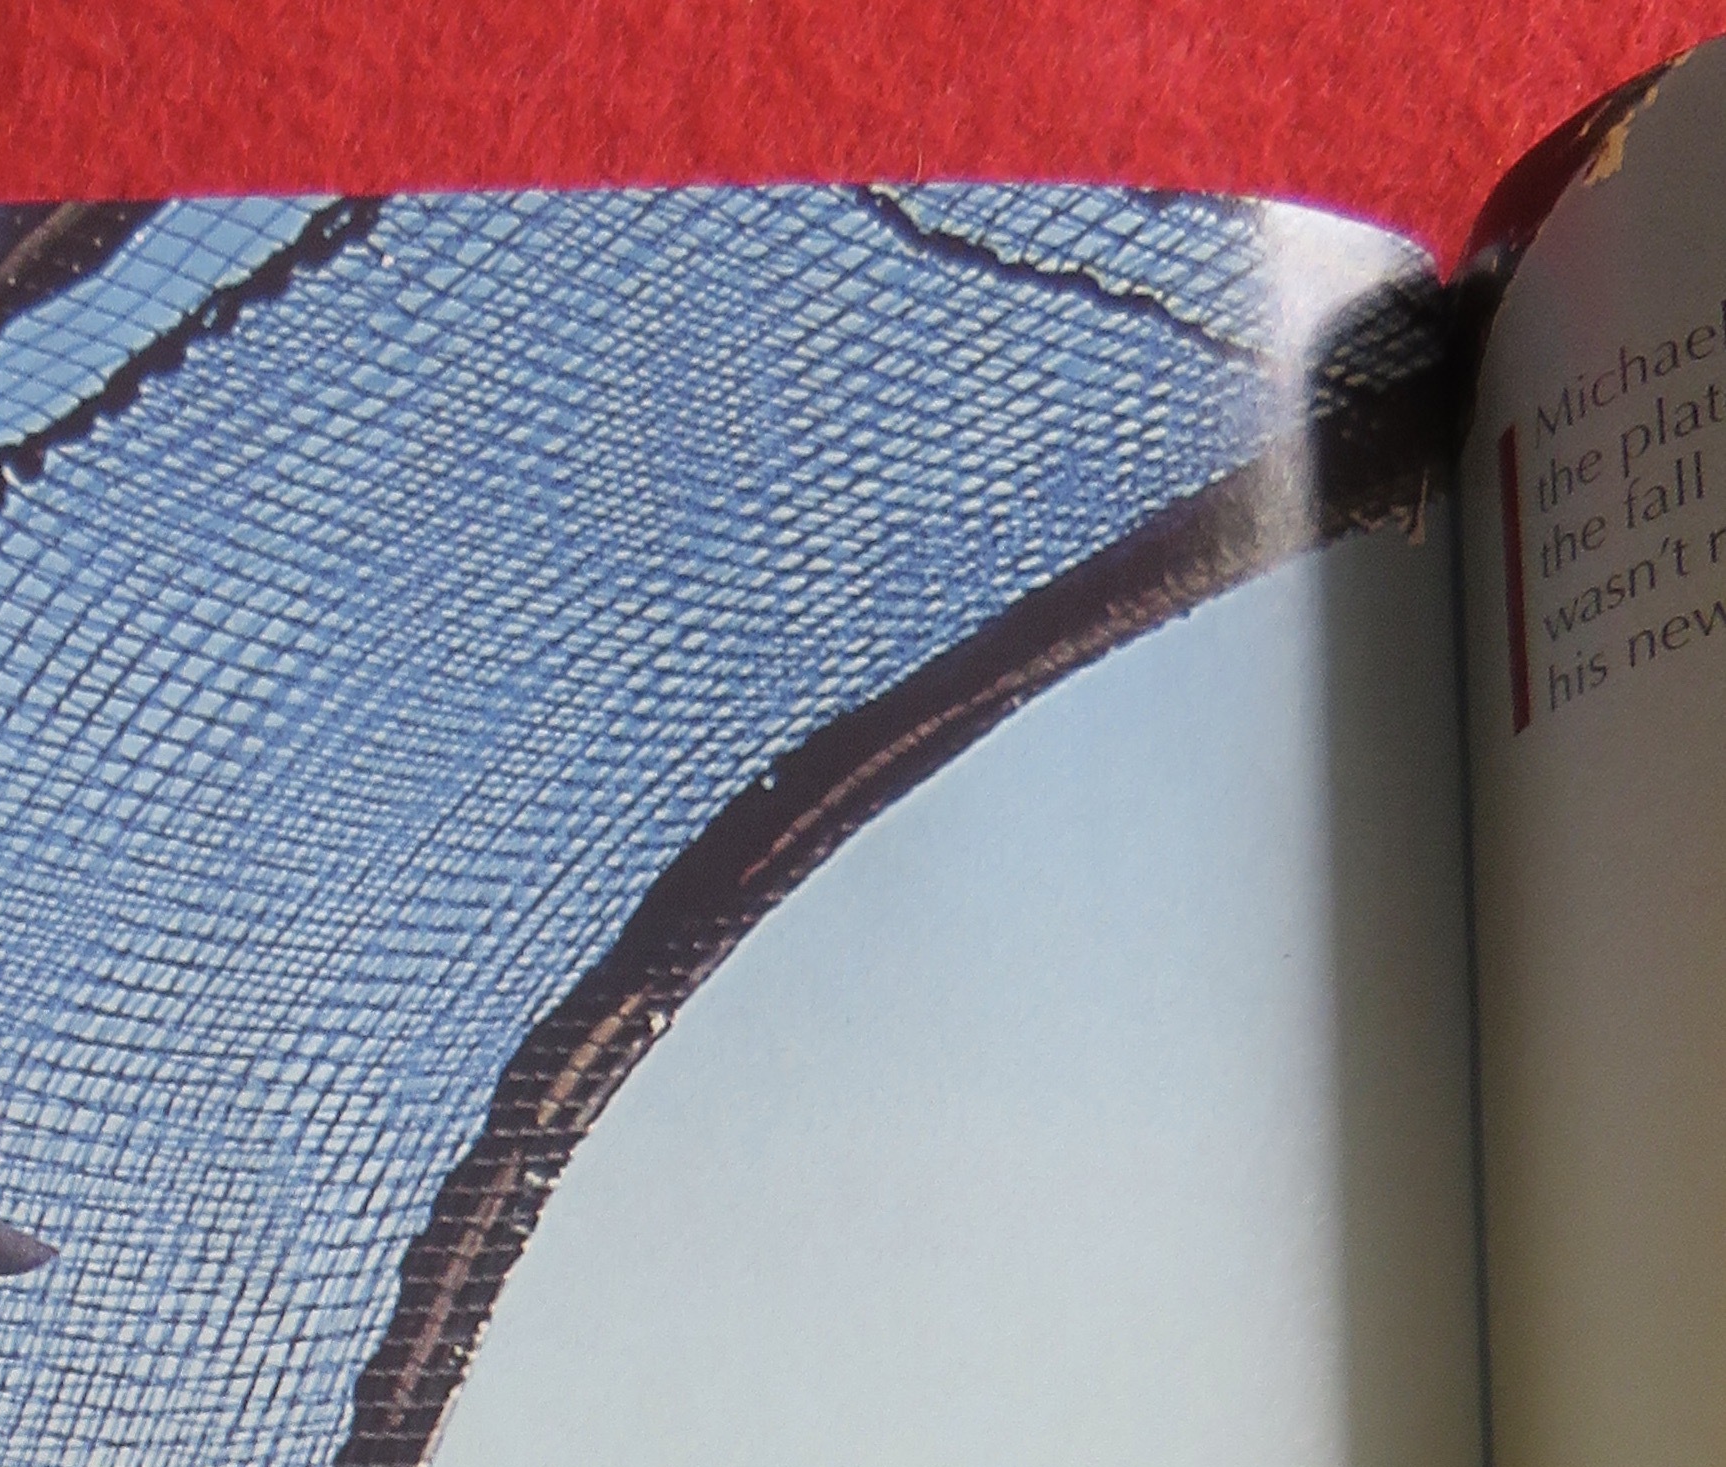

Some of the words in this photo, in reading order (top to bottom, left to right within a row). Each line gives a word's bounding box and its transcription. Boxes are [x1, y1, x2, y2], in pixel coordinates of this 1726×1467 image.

[1537, 448, 1603, 514] the
[1541, 515, 1607, 579] the
[1623, 450, 1704, 530] fall
[1543, 535, 1690, 642] wasn't
[1547, 650, 1608, 711] his
